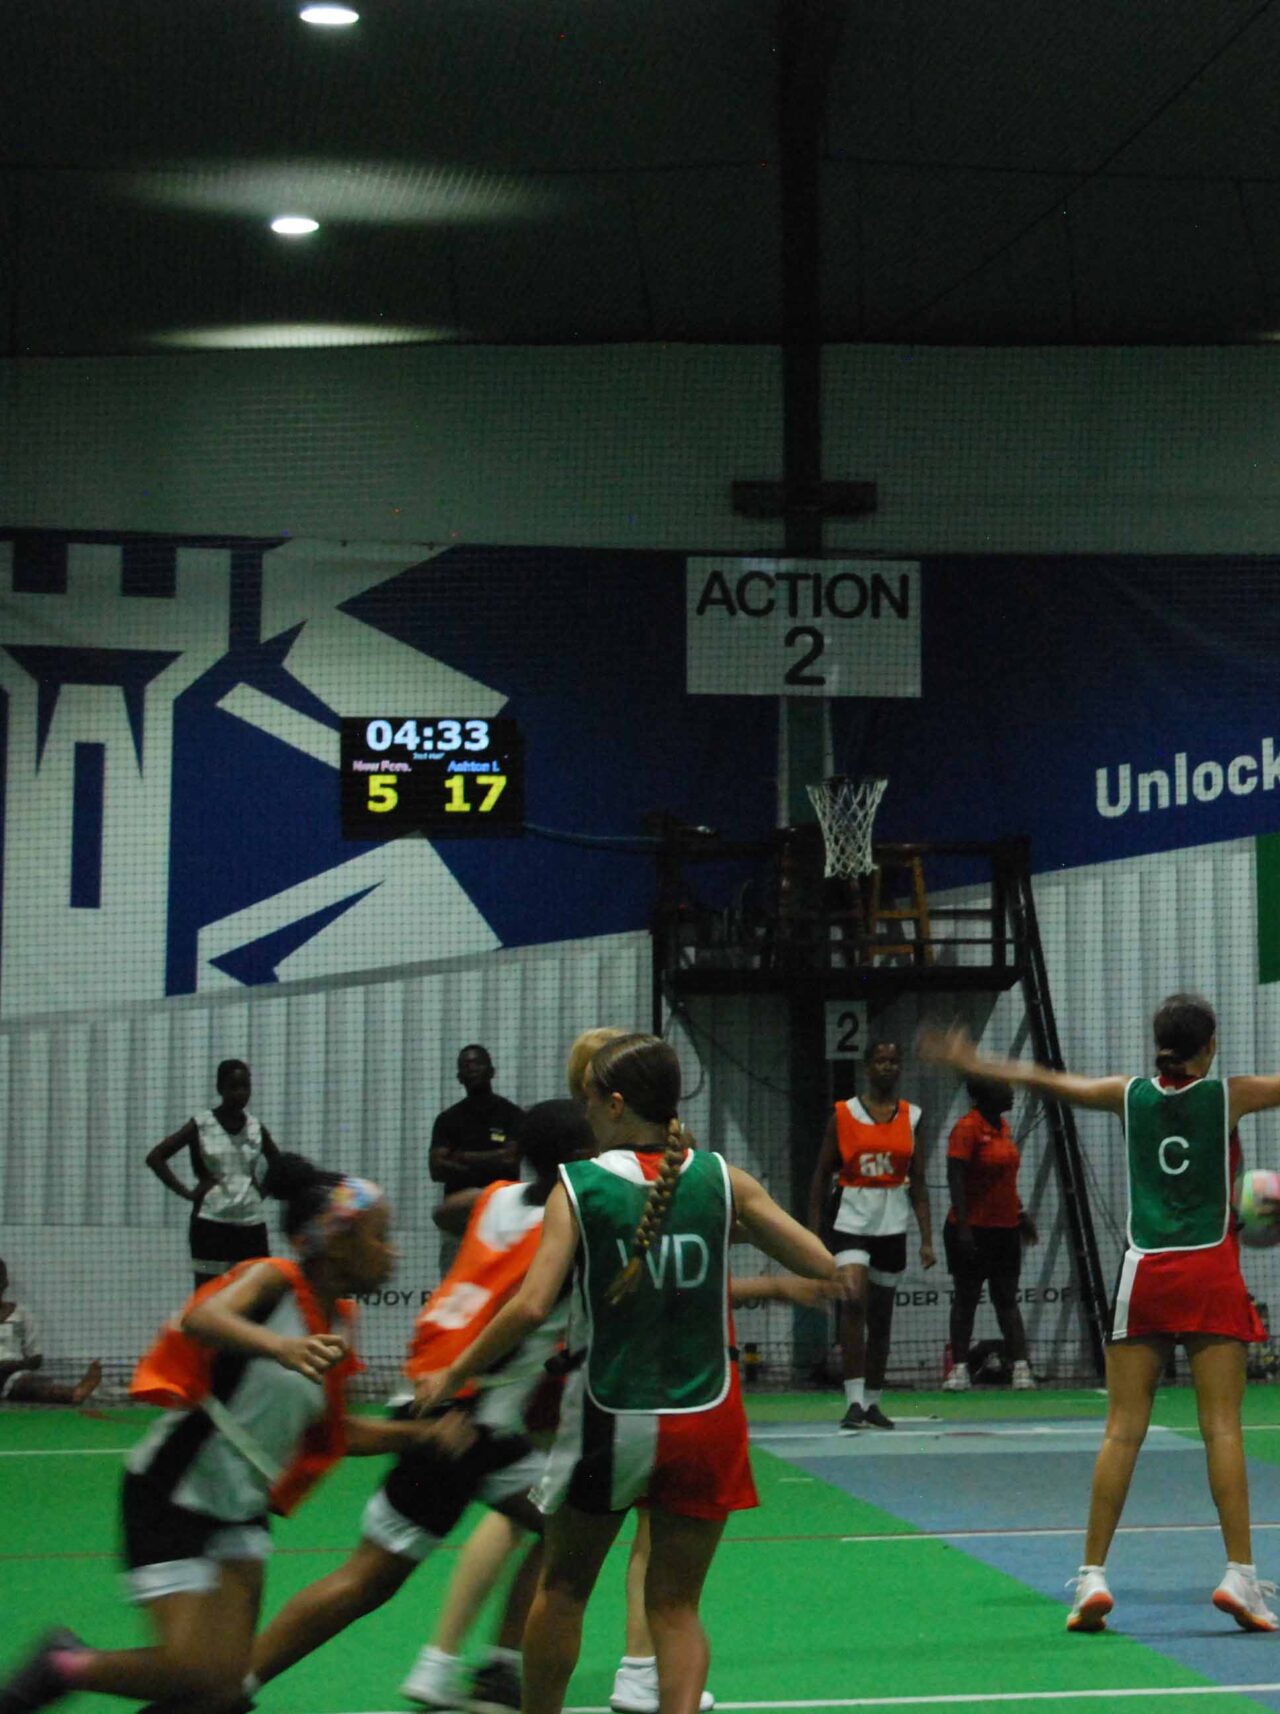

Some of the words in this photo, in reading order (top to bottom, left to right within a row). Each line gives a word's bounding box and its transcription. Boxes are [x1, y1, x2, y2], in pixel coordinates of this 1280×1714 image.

[696, 570, 910, 619] ACTION
[784, 626, 826, 686] 2
[366, 719, 490, 751] 04:33
[367, 774, 398, 813] 5
[444, 774, 507, 813] 17
[837, 1011, 860, 1052] 2
[1158, 1135, 1190, 1175] C
